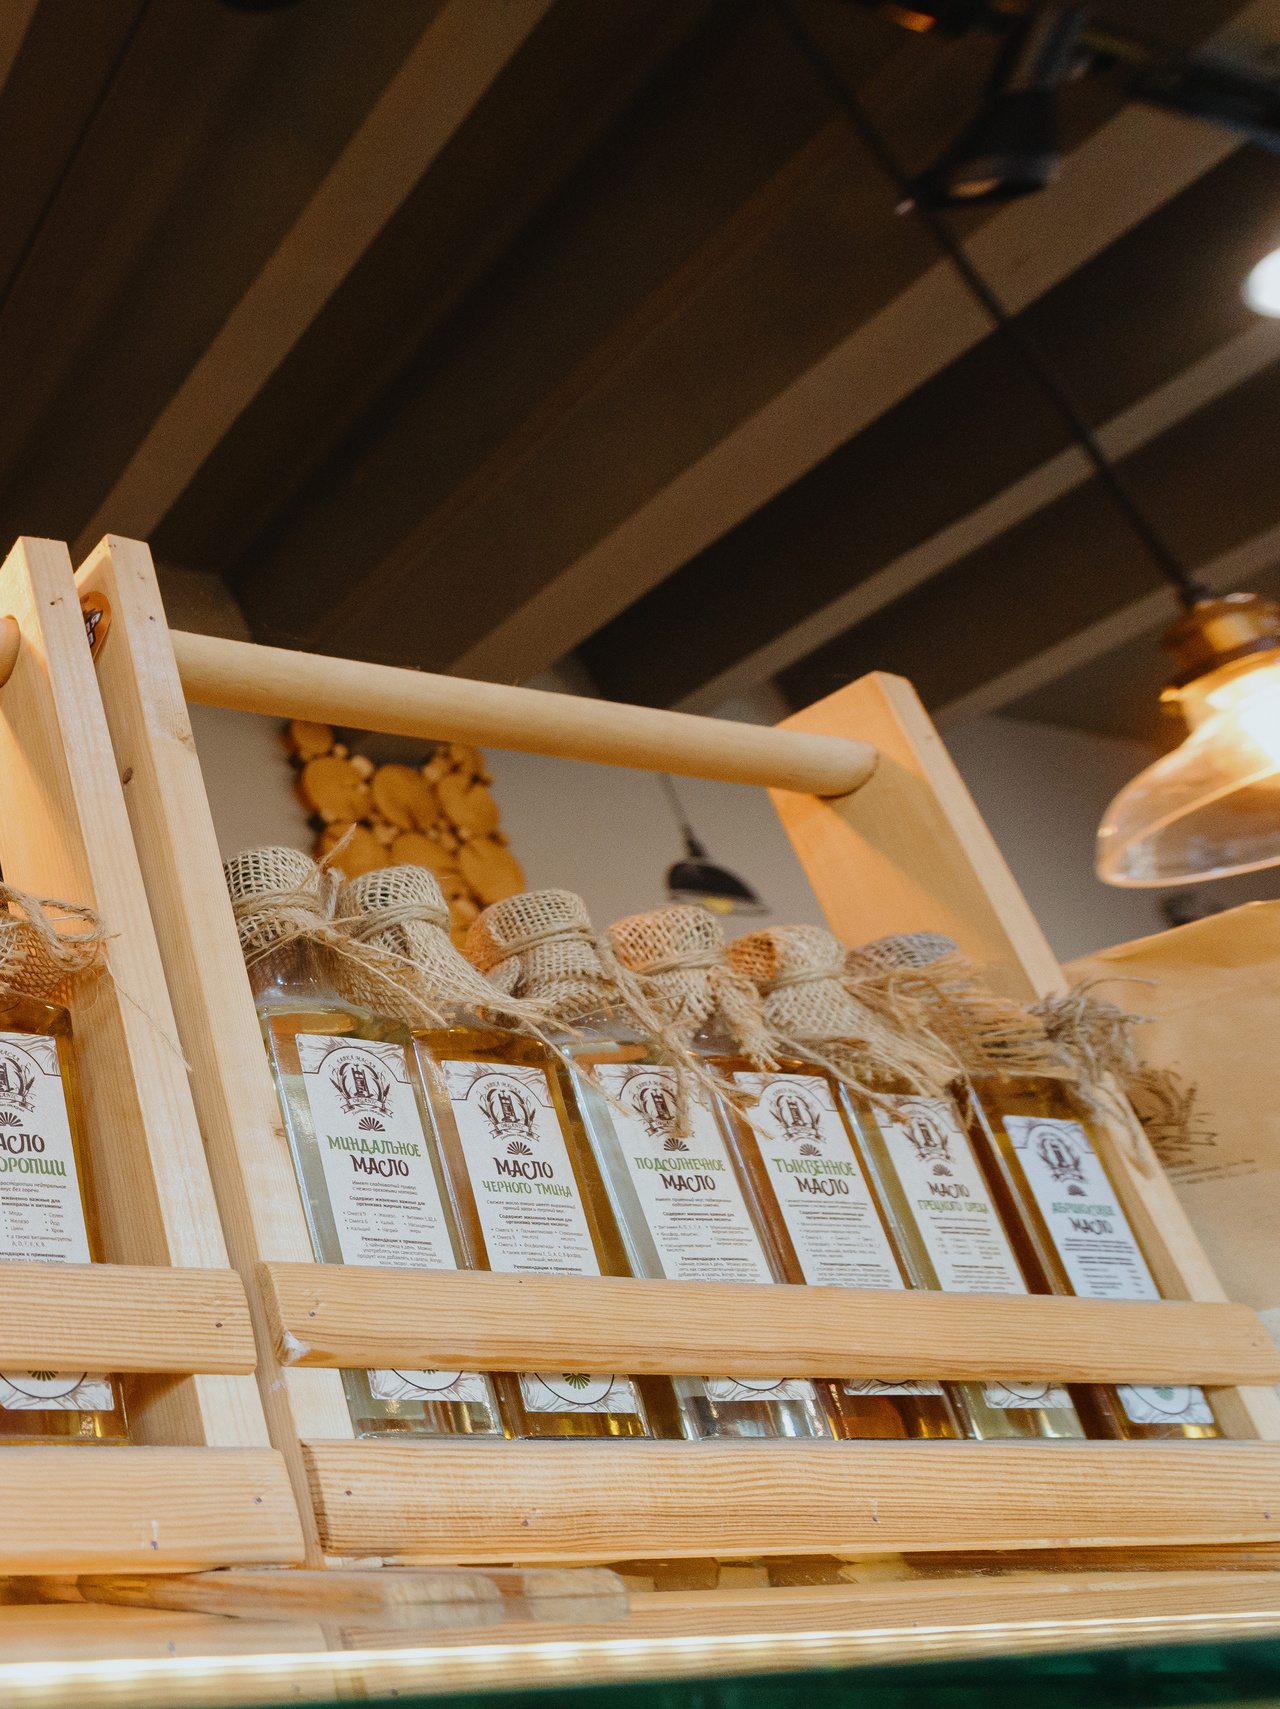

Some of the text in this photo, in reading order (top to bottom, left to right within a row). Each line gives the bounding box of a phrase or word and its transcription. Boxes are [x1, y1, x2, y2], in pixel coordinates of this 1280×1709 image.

[326, 1135, 421, 1158] МИНДАЛЬНОЕ
[349, 1154, 409, 1178] МАСЛО
[493, 1157, 554, 1180] МАСЛО
[634, 1157, 726, 1172] ПОДСОЛНЕЧНОЕ
[772, 1158, 857, 1177] ТЫКВЕННОЕ
[482, 1180, 573, 1197] ЧЕРНОГО ТМИНА
[659, 1173, 716, 1192] МАСЛО
[794, 1176, 849, 1196] МАСЛО
[927, 1181, 970, 1198] МАСЛО
[1068, 1217, 1114, 1235] МАСЛО
